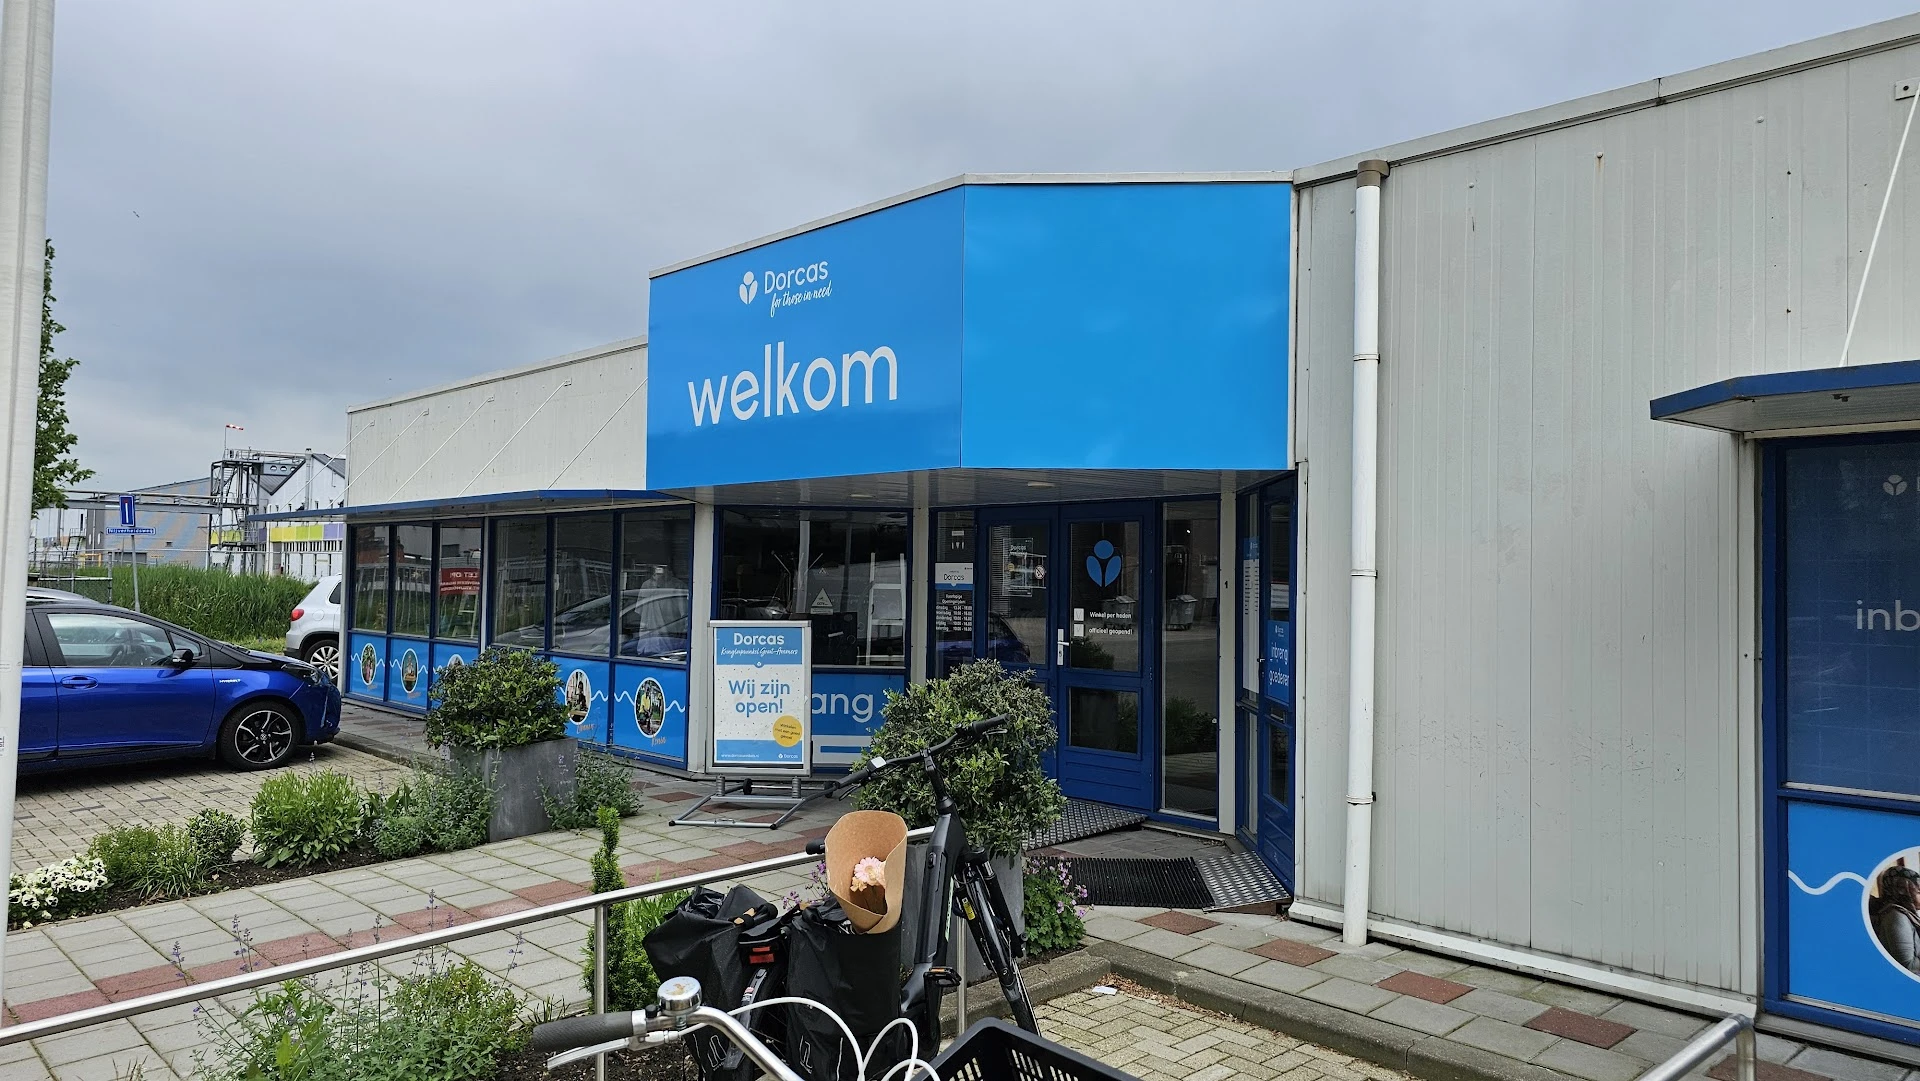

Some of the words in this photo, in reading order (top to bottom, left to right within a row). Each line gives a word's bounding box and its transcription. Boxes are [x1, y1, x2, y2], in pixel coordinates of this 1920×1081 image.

[764, 261, 828, 294] Dorcas
[771, 292, 782, 317] for
[783, 290, 803, 307] those
[803, 290, 812, 301] in
[813, 279, 833, 299] need
[687, 341, 898, 427] welkom
[733, 632, 785, 646] Dorcas
[728, 679, 756, 699] Wij
[760, 679, 791, 699] zijn
[735, 698, 783, 718] open!
